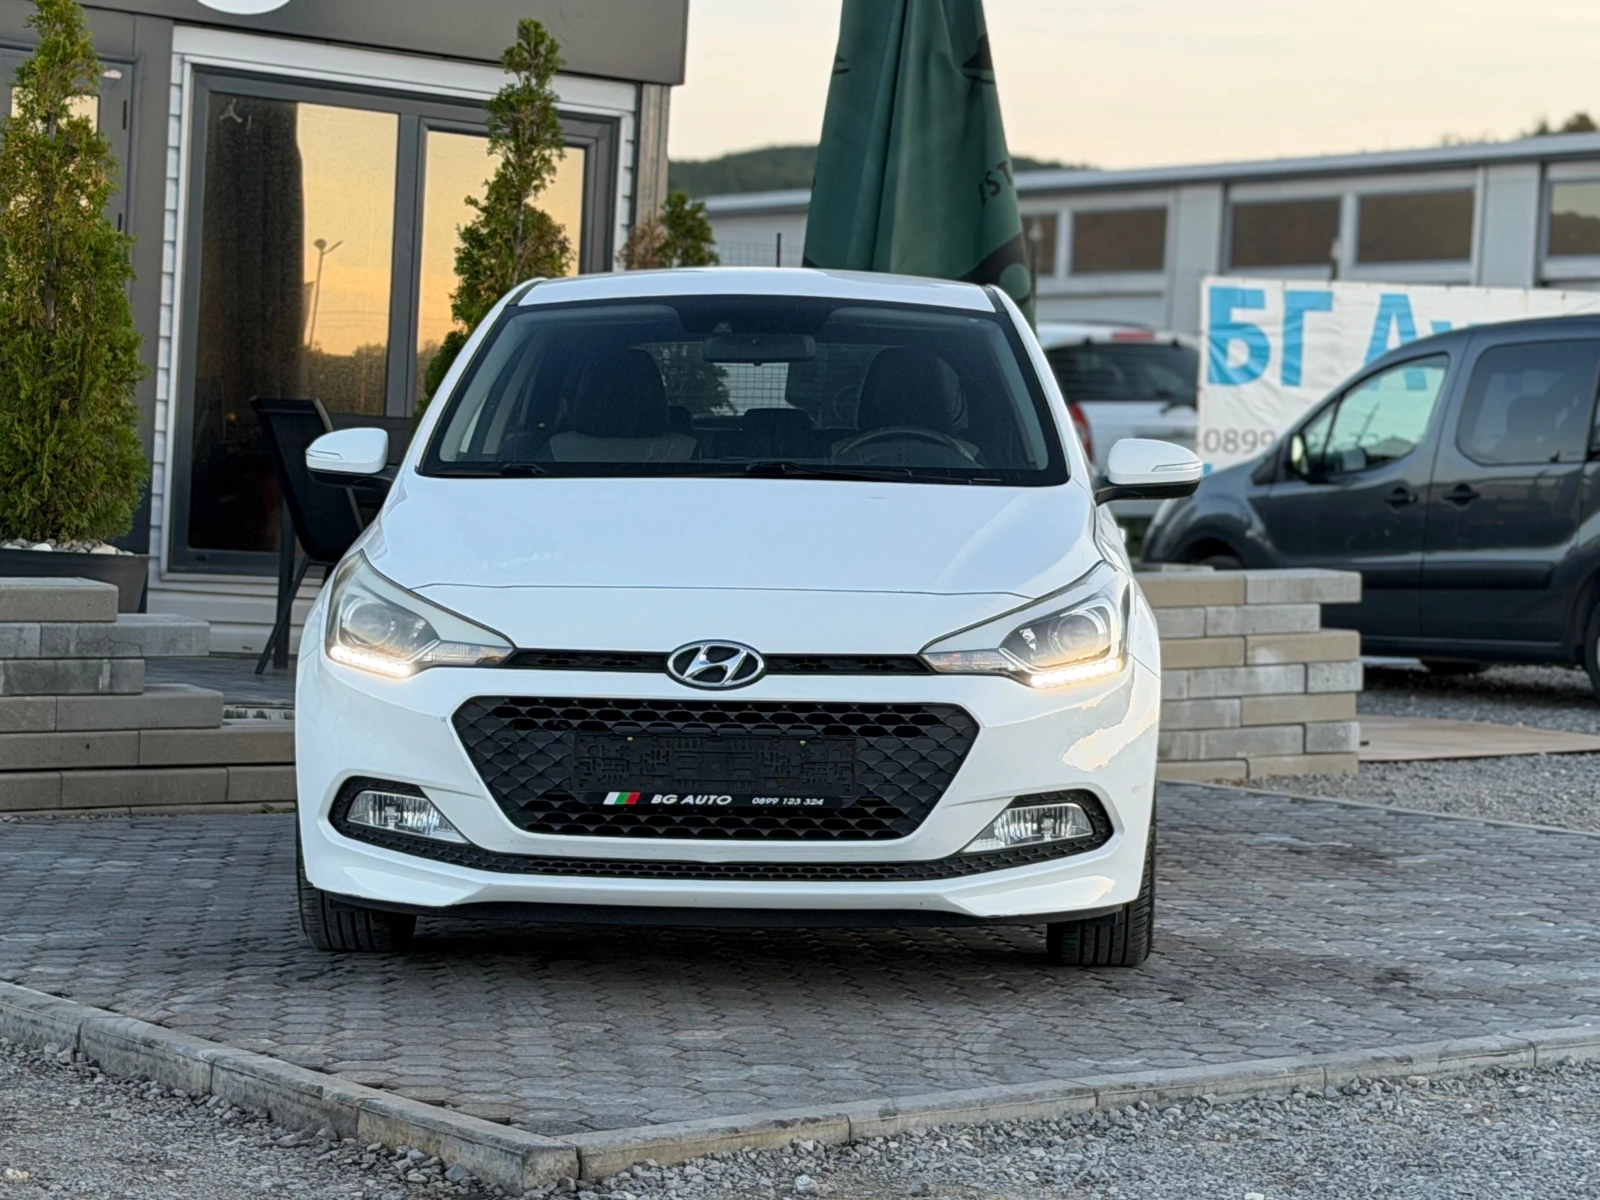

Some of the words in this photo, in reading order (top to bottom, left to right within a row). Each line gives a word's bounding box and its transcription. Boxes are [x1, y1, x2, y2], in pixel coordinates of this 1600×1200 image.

[1208, 286, 1334, 387] БГ
[650, 793, 678, 805] BG
[680, 794, 732, 806] AUTO
[751, 796, 780, 805] 0899
[782, 797, 802, 806] 123
[803, 798, 825, 806] 324
